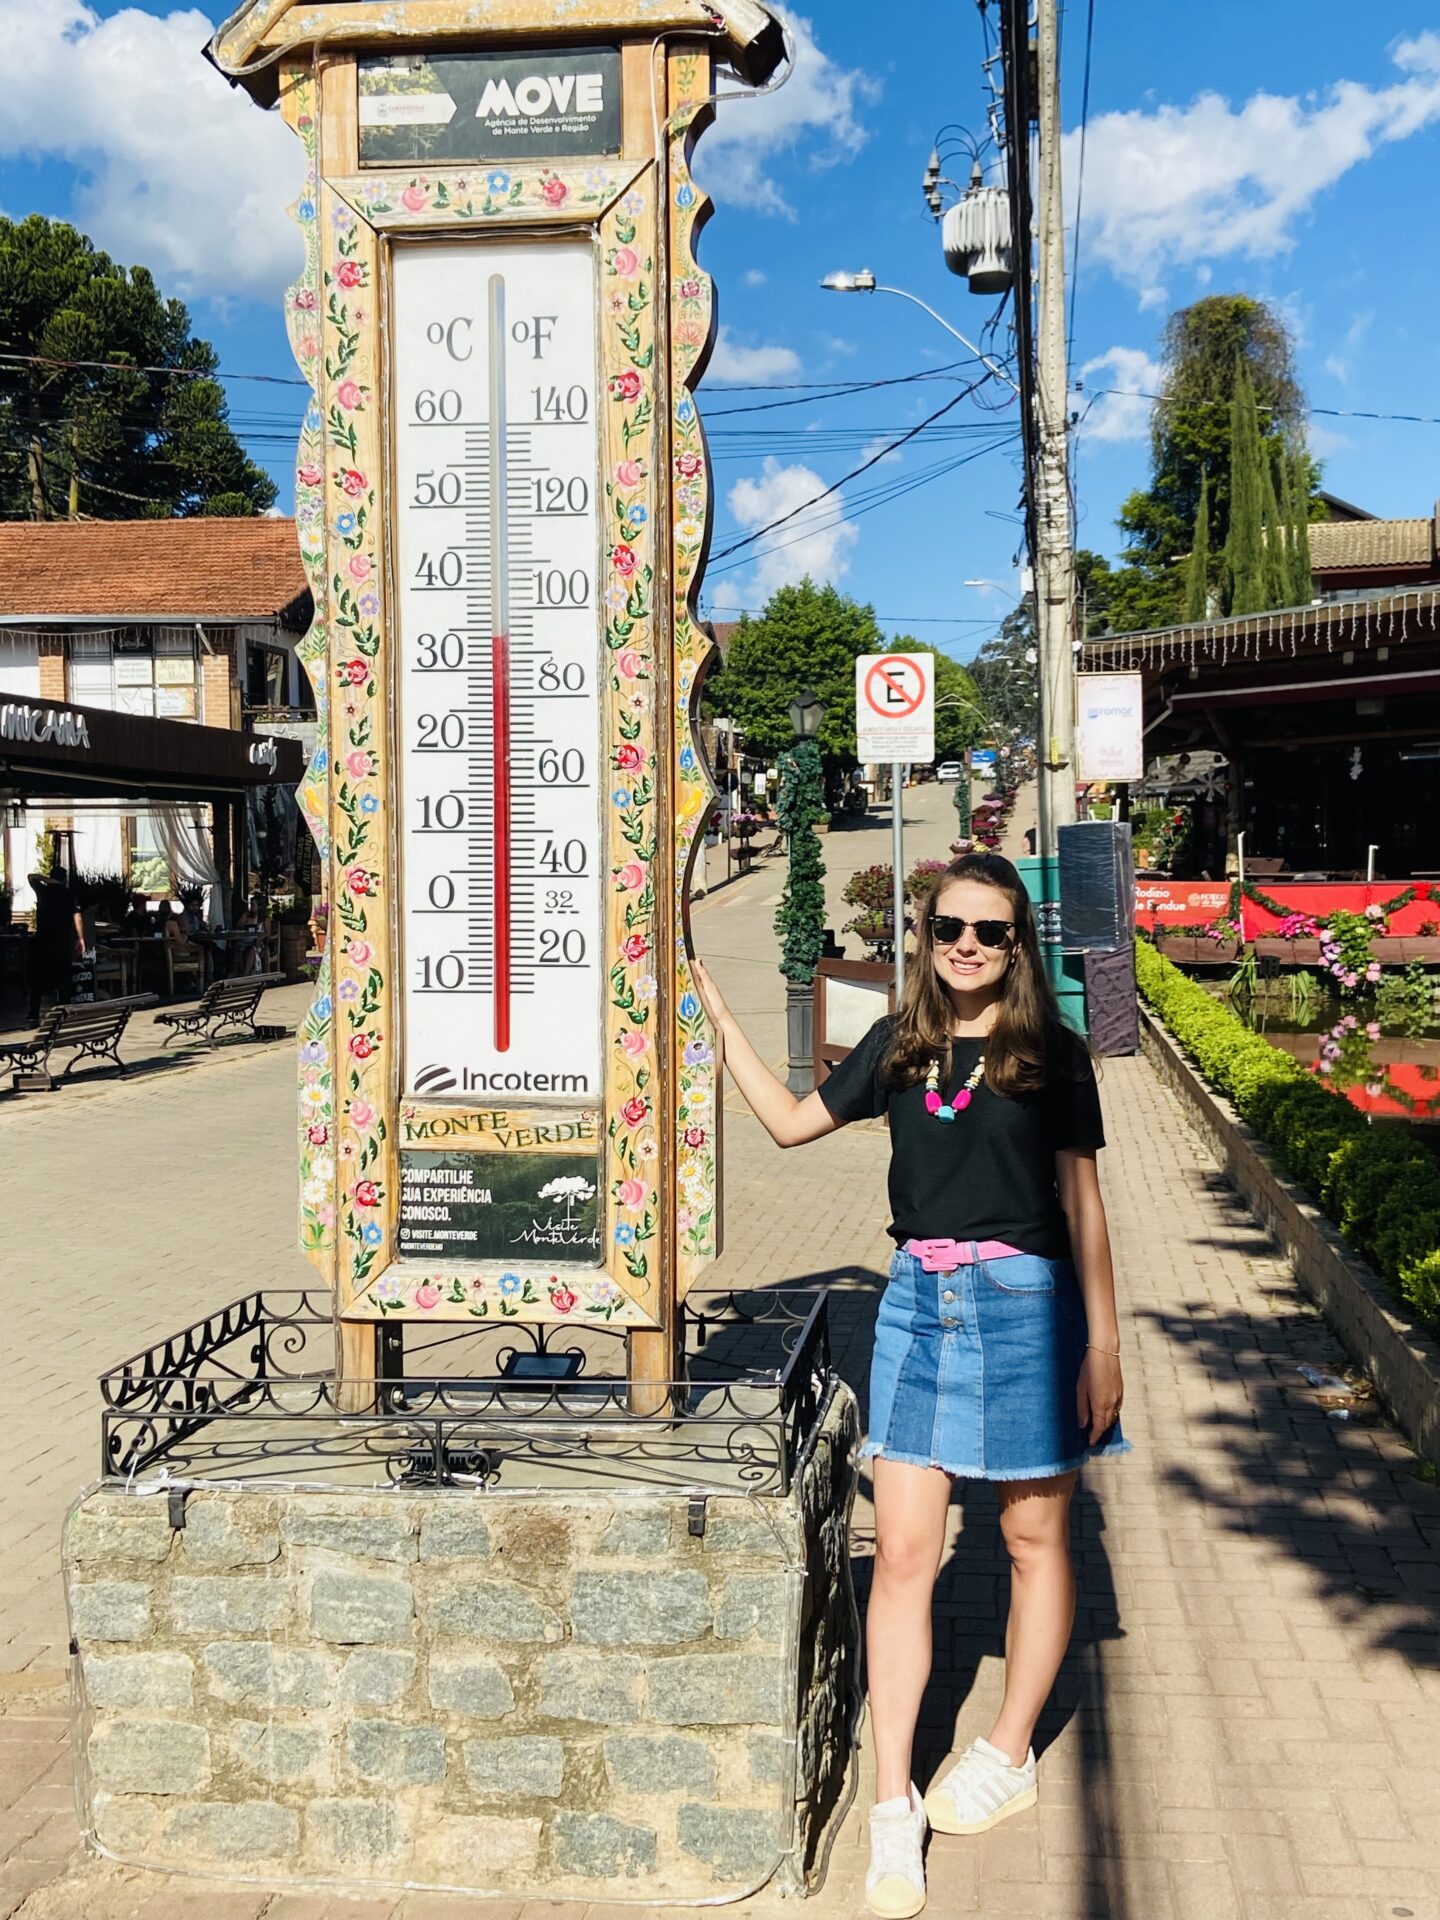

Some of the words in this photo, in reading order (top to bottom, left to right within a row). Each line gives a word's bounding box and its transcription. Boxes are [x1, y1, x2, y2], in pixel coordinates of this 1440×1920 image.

[475, 74, 603, 117] MOVE
[485, 118, 516, 128] Agência
[529, 114, 596, 125] Desenvolvimento
[492, 127, 502, 135] de
[504, 126, 529, 134] Monte
[530, 125, 553, 133] Verde
[561, 124, 589, 133] Região
[415, 389, 462, 422] 60
[531, 385, 588, 421] 140
[414, 469, 461, 505] 50
[531, 476, 588, 512] 120
[414, 551, 462, 586] 40
[533, 569, 589, 604] 100
[416, 633, 464, 668] 30
[538, 656, 585, 691] 80
[1, 704, 91, 748] MUCAMA
[417, 713, 464, 748] 20
[538, 748, 585, 782] 60
[416, 795, 464, 829] 10
[539, 839, 587, 873] 40
[428, 875, 455, 909] 0
[545, 890, 573, 908] 32
[1147, 899, 1186, 911] Fndue
[539, 929, 586, 963] 20
[415, 955, 464, 988] -10
[463, 1067, 588, 1092] Incoterm
[404, 1111, 509, 1141] MONTE
[494, 1121, 594, 1149] VERDE
[401, 1168, 474, 1184] COMPARTILHE
[402, 1187, 421, 1201] SUA
[423, 1186, 492, 1203] EXPERIÊNCIA
[401, 1205, 452, 1221] CONOSCO.
[533, 1216, 581, 1231] Visite
